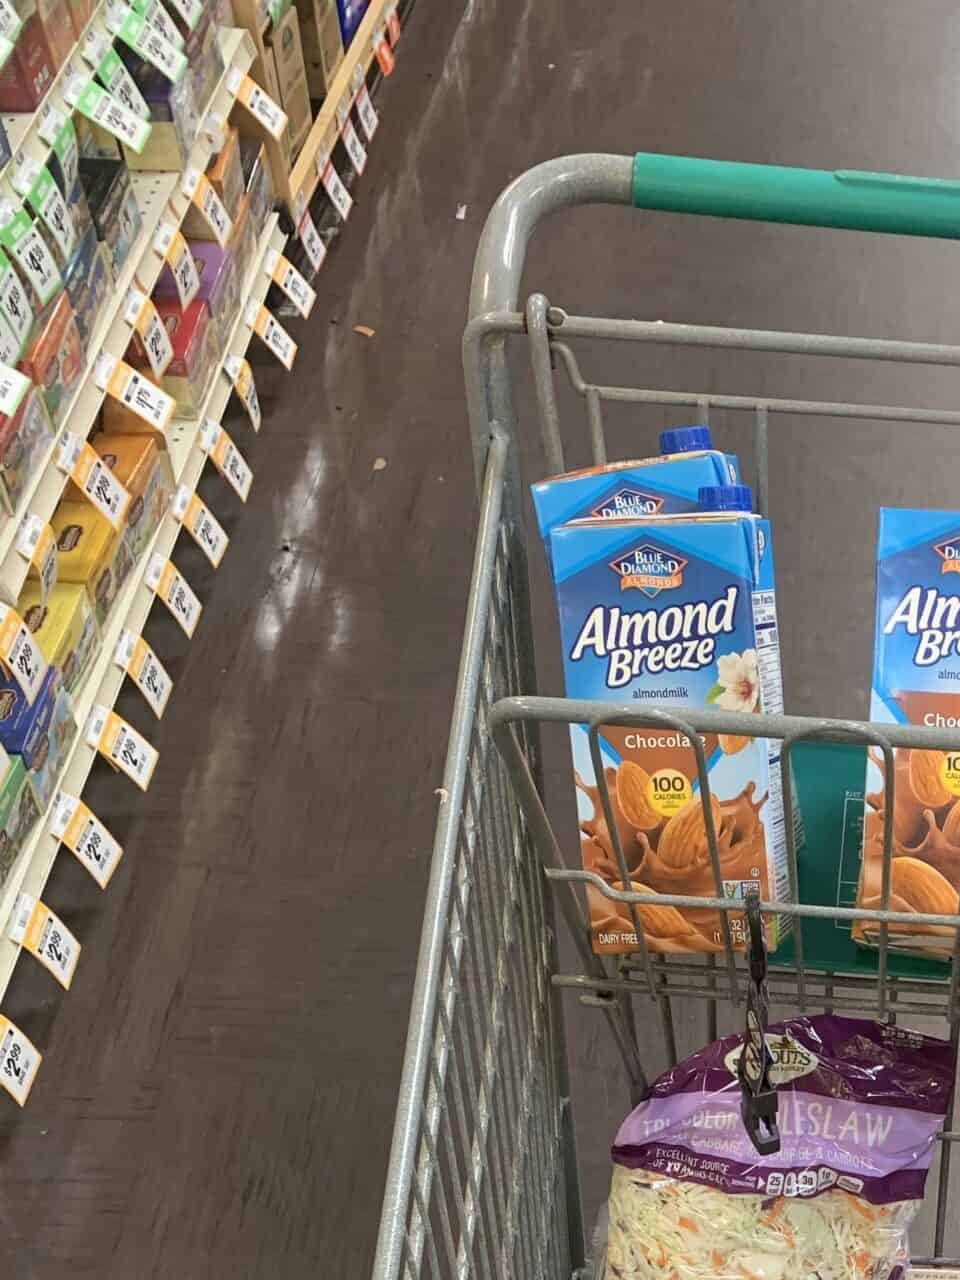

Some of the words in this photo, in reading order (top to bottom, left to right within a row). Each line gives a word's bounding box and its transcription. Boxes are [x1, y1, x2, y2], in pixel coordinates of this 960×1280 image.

[601, 500, 657, 518] DIAMOND
[614, 494, 642, 509] BLUE
[634, 551, 664, 565] BLUE
[620, 560, 679, 576] DIAMOND
[570, 587, 738, 660] Almond
[606, 637, 716, 688] Breeze
[632, 686, 689, 700] almondmilk
[624, 732, 707, 750] Chocolae
[652, 776, 685, 793] 100
[599, 933, 619, 945] DAIRY
[621, 933, 639, 945] FREE
[3, 1043, 22, 1078] $299
[700, 1161, 730, 1175] SOURCE
[769, 1175, 781, 1185] 25
